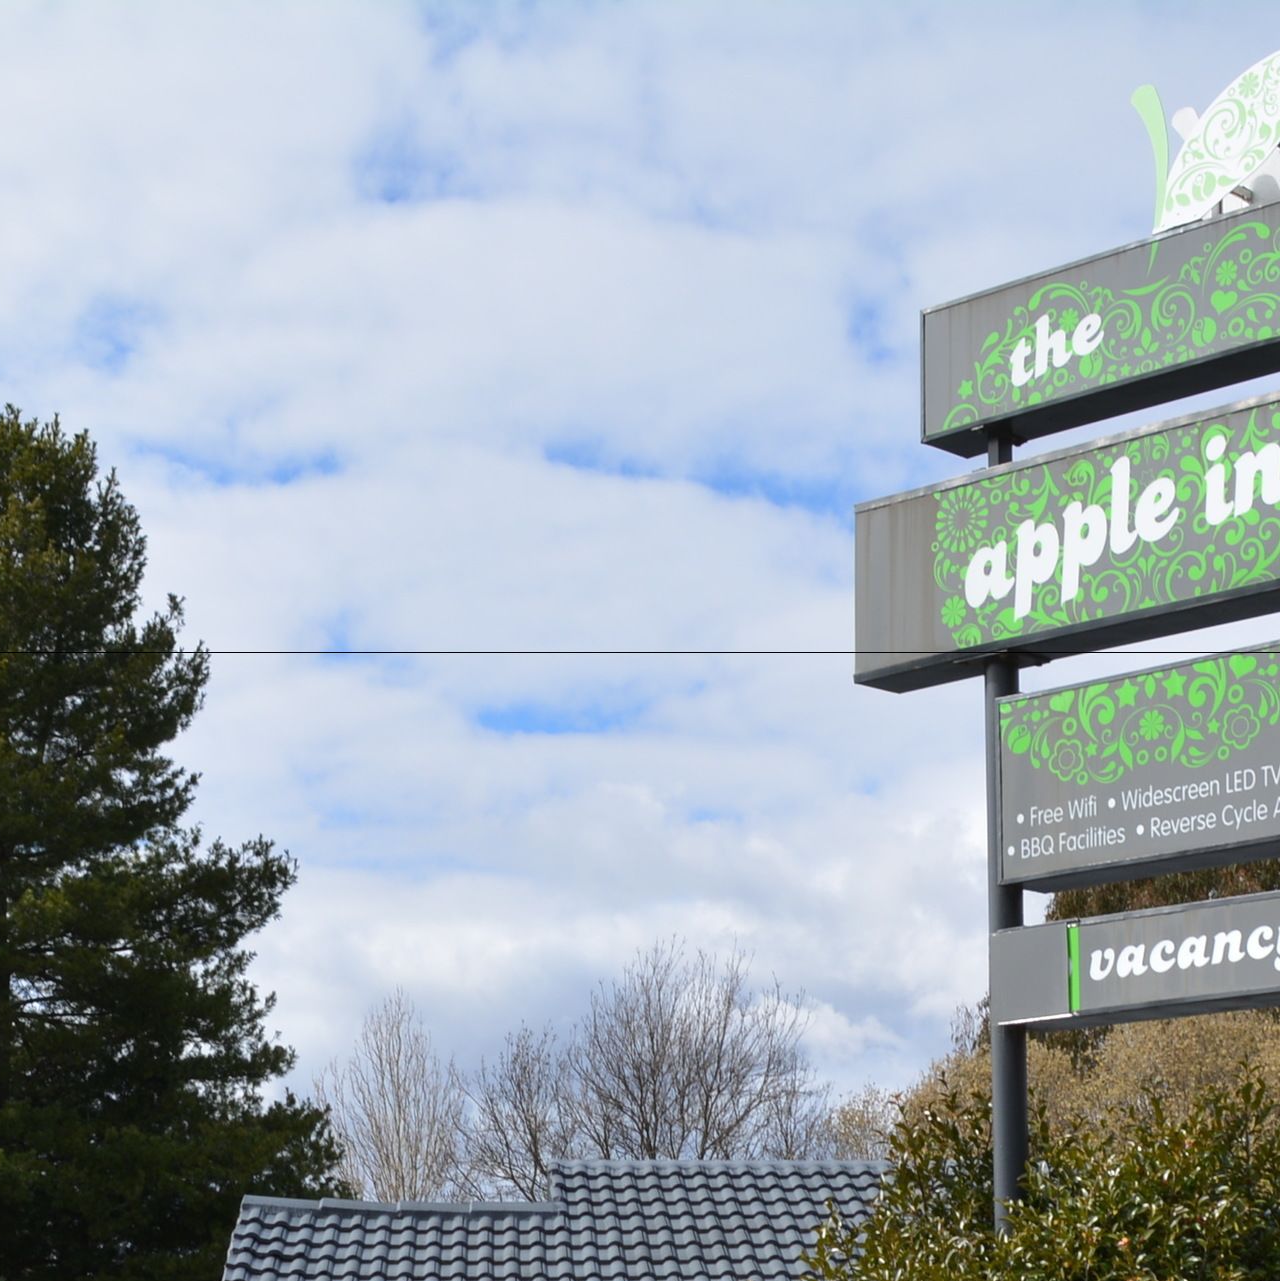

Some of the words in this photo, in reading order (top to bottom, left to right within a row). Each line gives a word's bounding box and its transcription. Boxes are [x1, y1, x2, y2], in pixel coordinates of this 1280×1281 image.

[1010, 313, 1104, 386] the
[965, 457, 1180, 621] apple
[1121, 777, 1220, 811] Widescreen
[1226, 768, 1256, 794] LED
[1030, 806, 1064, 827] Free
[1068, 795, 1097, 820] Wifi
[1150, 811, 1217, 838] Reverse
[1221, 799, 1269, 831] Cycle
[1021, 834, 1055, 859] BBQ
[1059, 826, 1126, 853] Facilities
